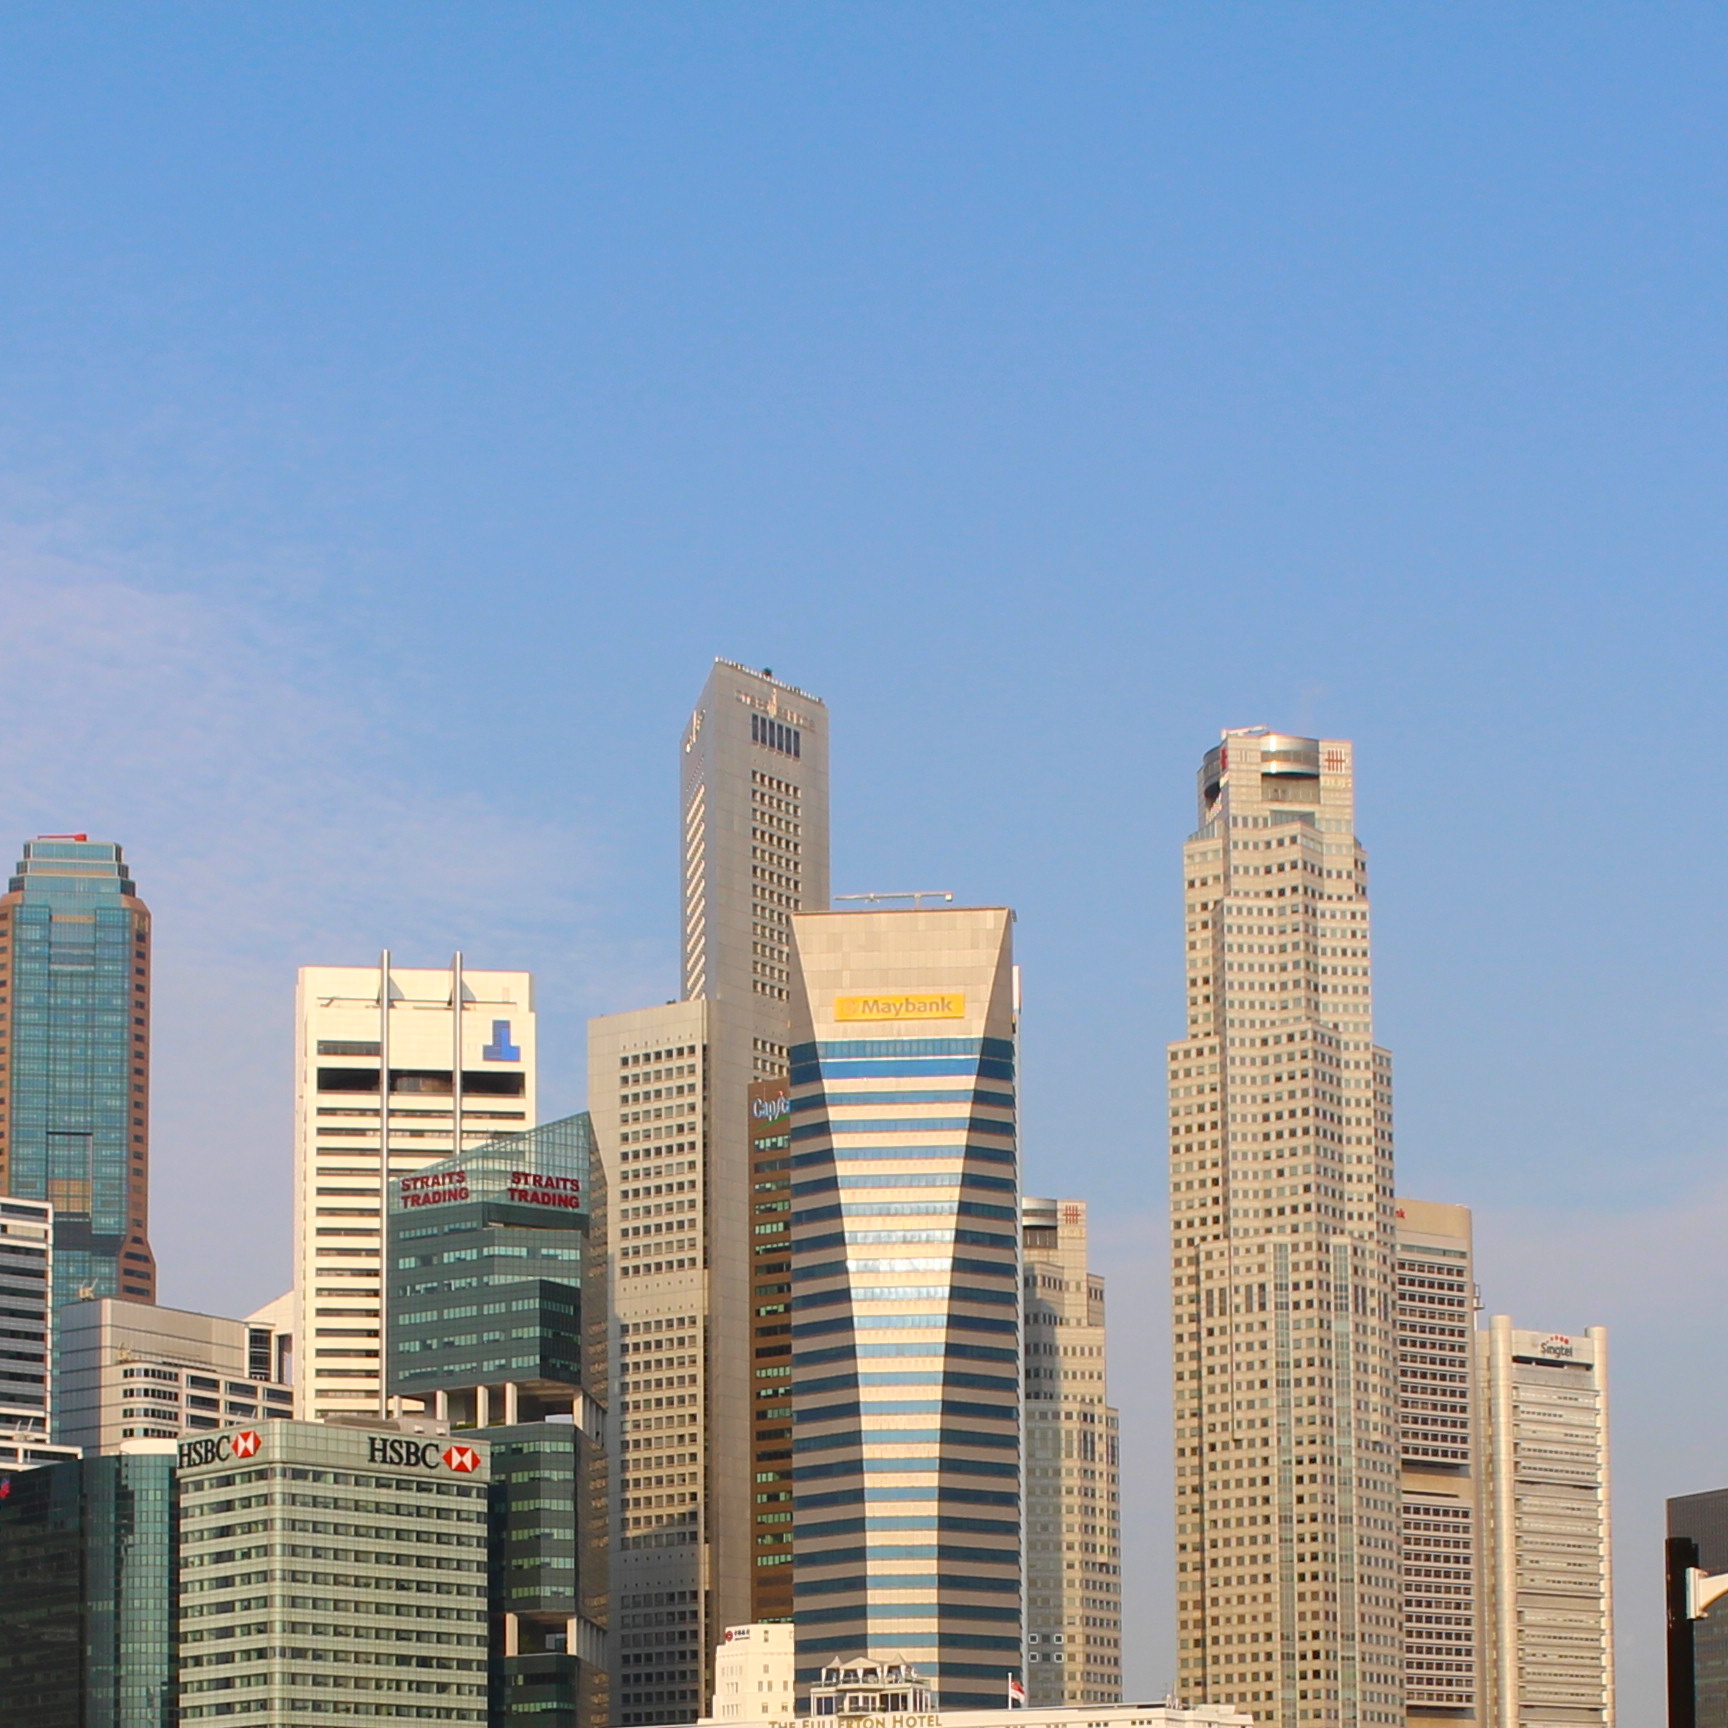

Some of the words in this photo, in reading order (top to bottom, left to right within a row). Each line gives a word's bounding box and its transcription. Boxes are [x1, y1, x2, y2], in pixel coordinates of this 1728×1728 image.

[861, 997, 953, 1016] Maybank
[401, 1170, 466, 1192] STRAITS
[511, 1171, 580, 1192] STRAITS
[401, 1188, 469, 1209] TRADING
[508, 1188, 580, 1209] TRADING
[1541, 1342, 1573, 1358] Singtel
[177, 1435, 231, 1469] HSBC
[368, 1436, 440, 1469] HSBC
[893, 1715, 943, 1728] HOTEL
